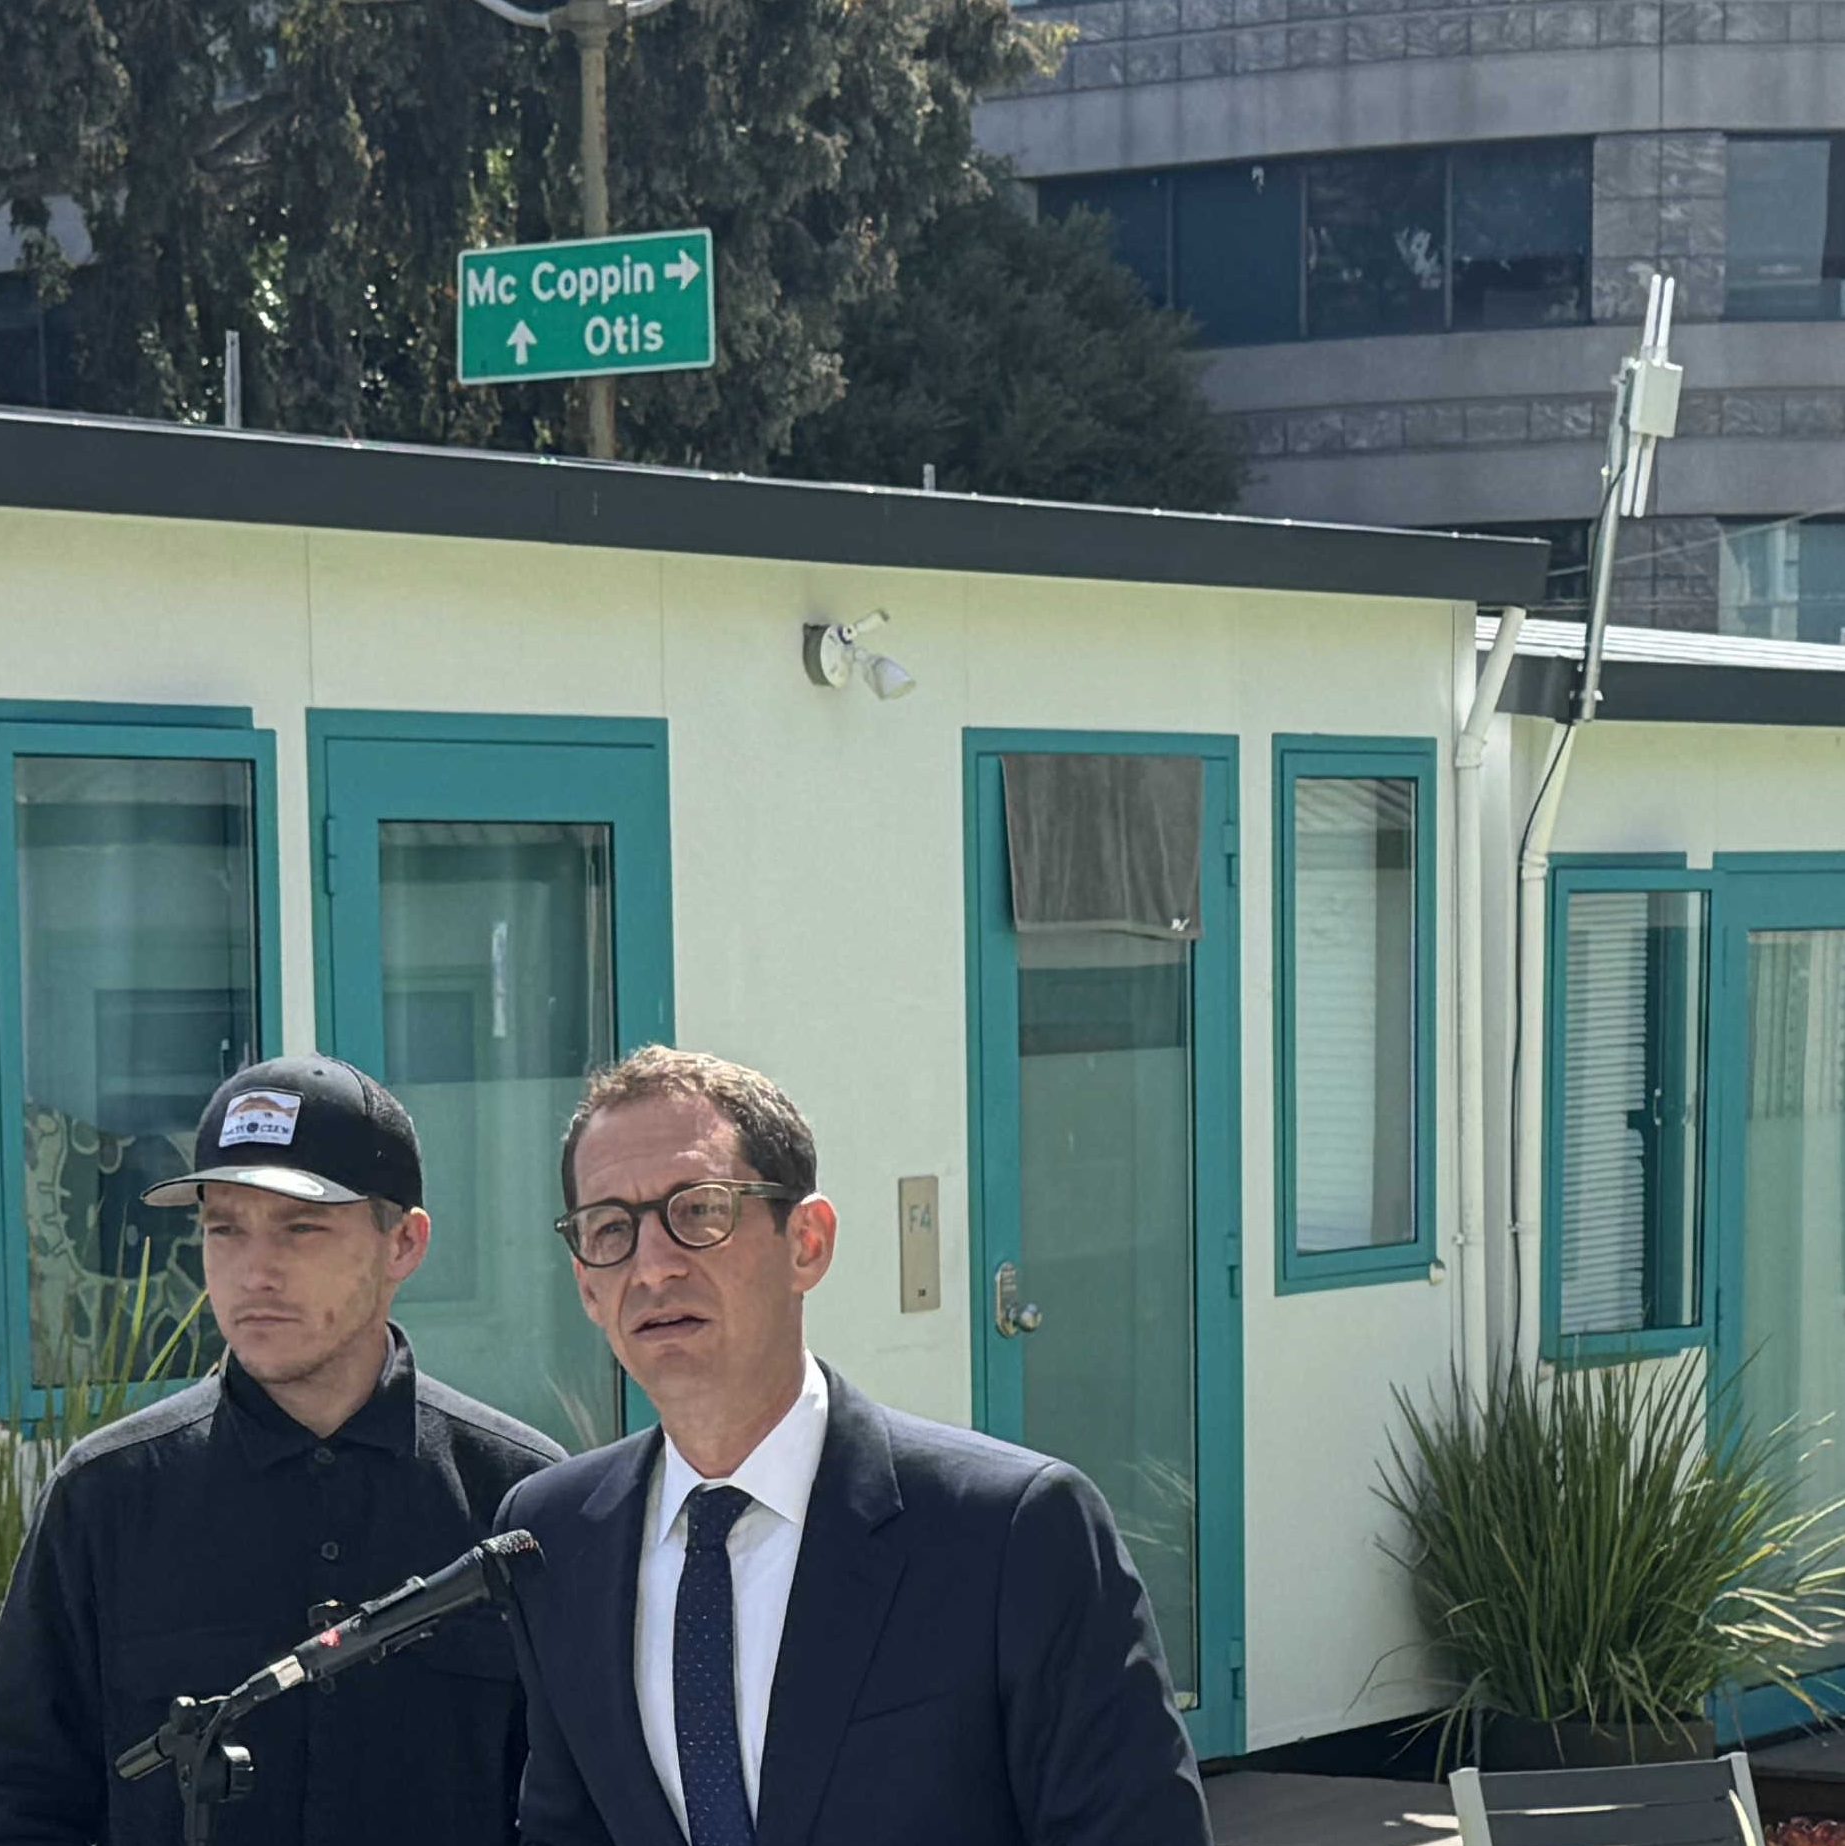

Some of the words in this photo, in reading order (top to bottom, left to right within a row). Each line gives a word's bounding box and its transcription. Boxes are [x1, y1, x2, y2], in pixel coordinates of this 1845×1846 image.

[467, 265, 518, 307] Mc
[531, 254, 655, 307] Coppin
[584, 313, 664, 356] Otis
